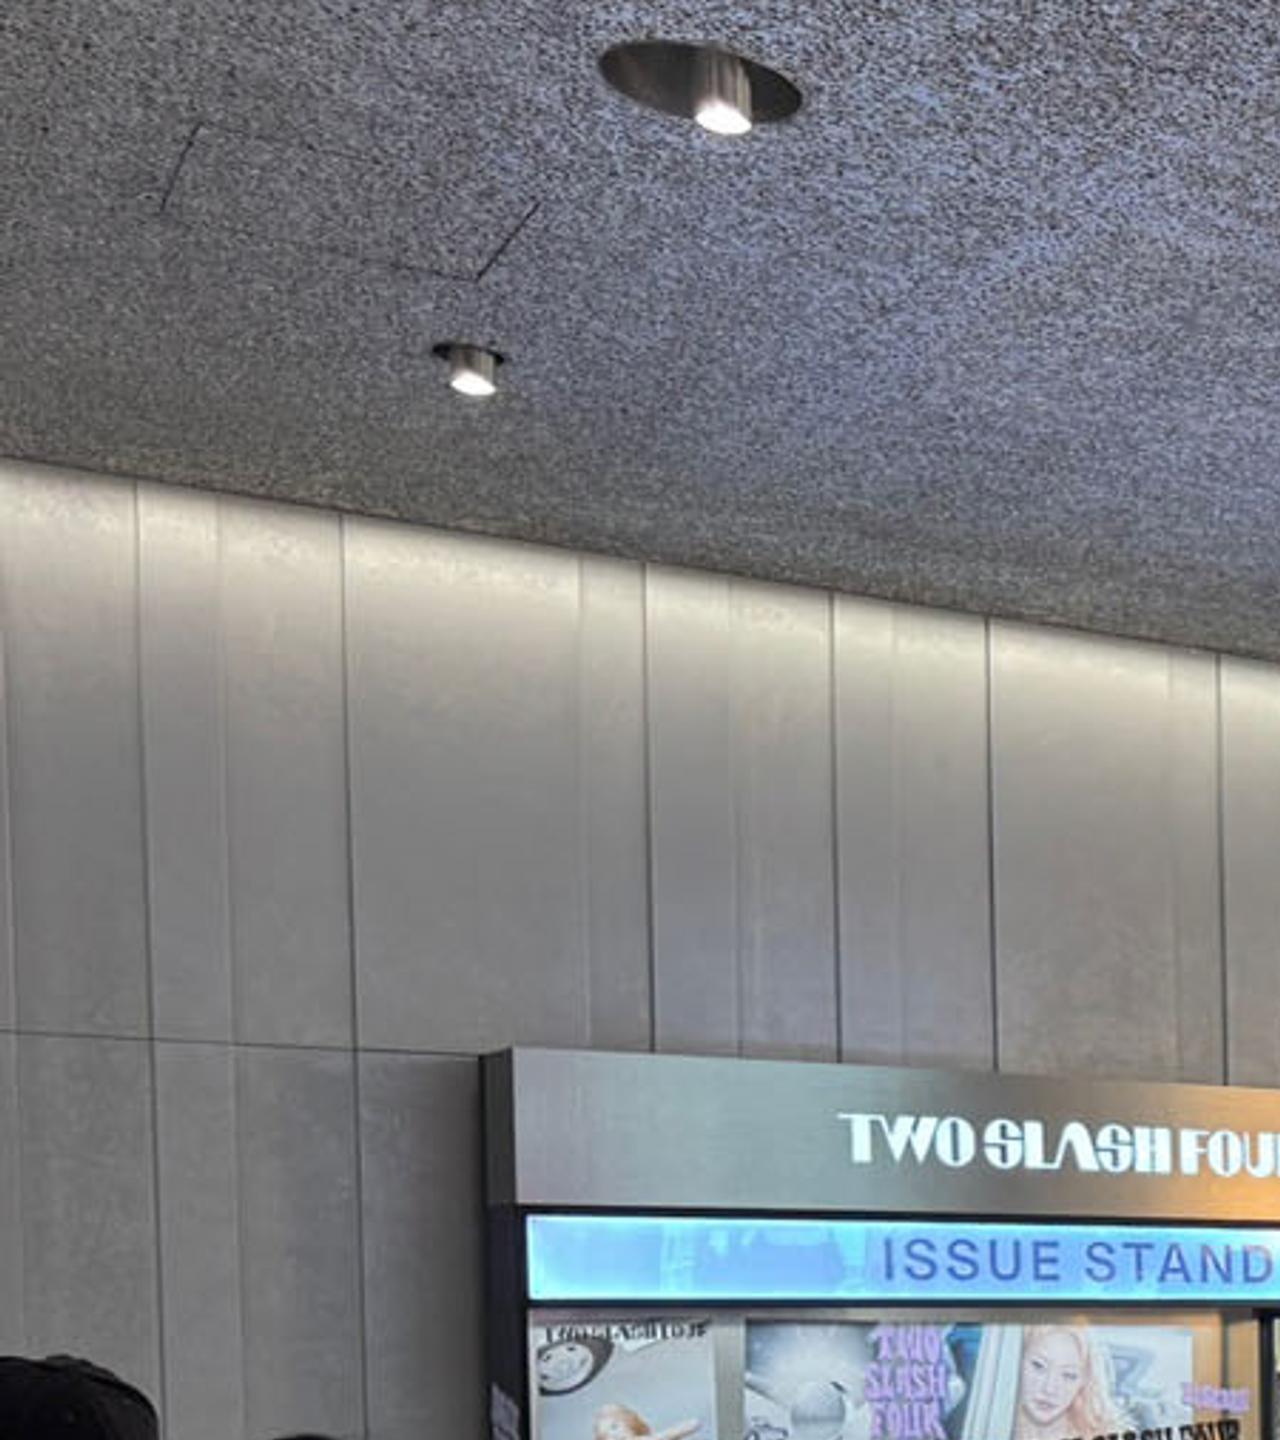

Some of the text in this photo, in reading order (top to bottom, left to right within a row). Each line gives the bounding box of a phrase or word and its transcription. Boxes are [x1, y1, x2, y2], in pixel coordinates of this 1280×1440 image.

[837, 1113, 975, 1168] TWO
[983, 1117, 1172, 1175] SLASH
[884, 1238, 1274, 1285] ISSUE STAND
[877, 1325, 940, 1361] TWO
